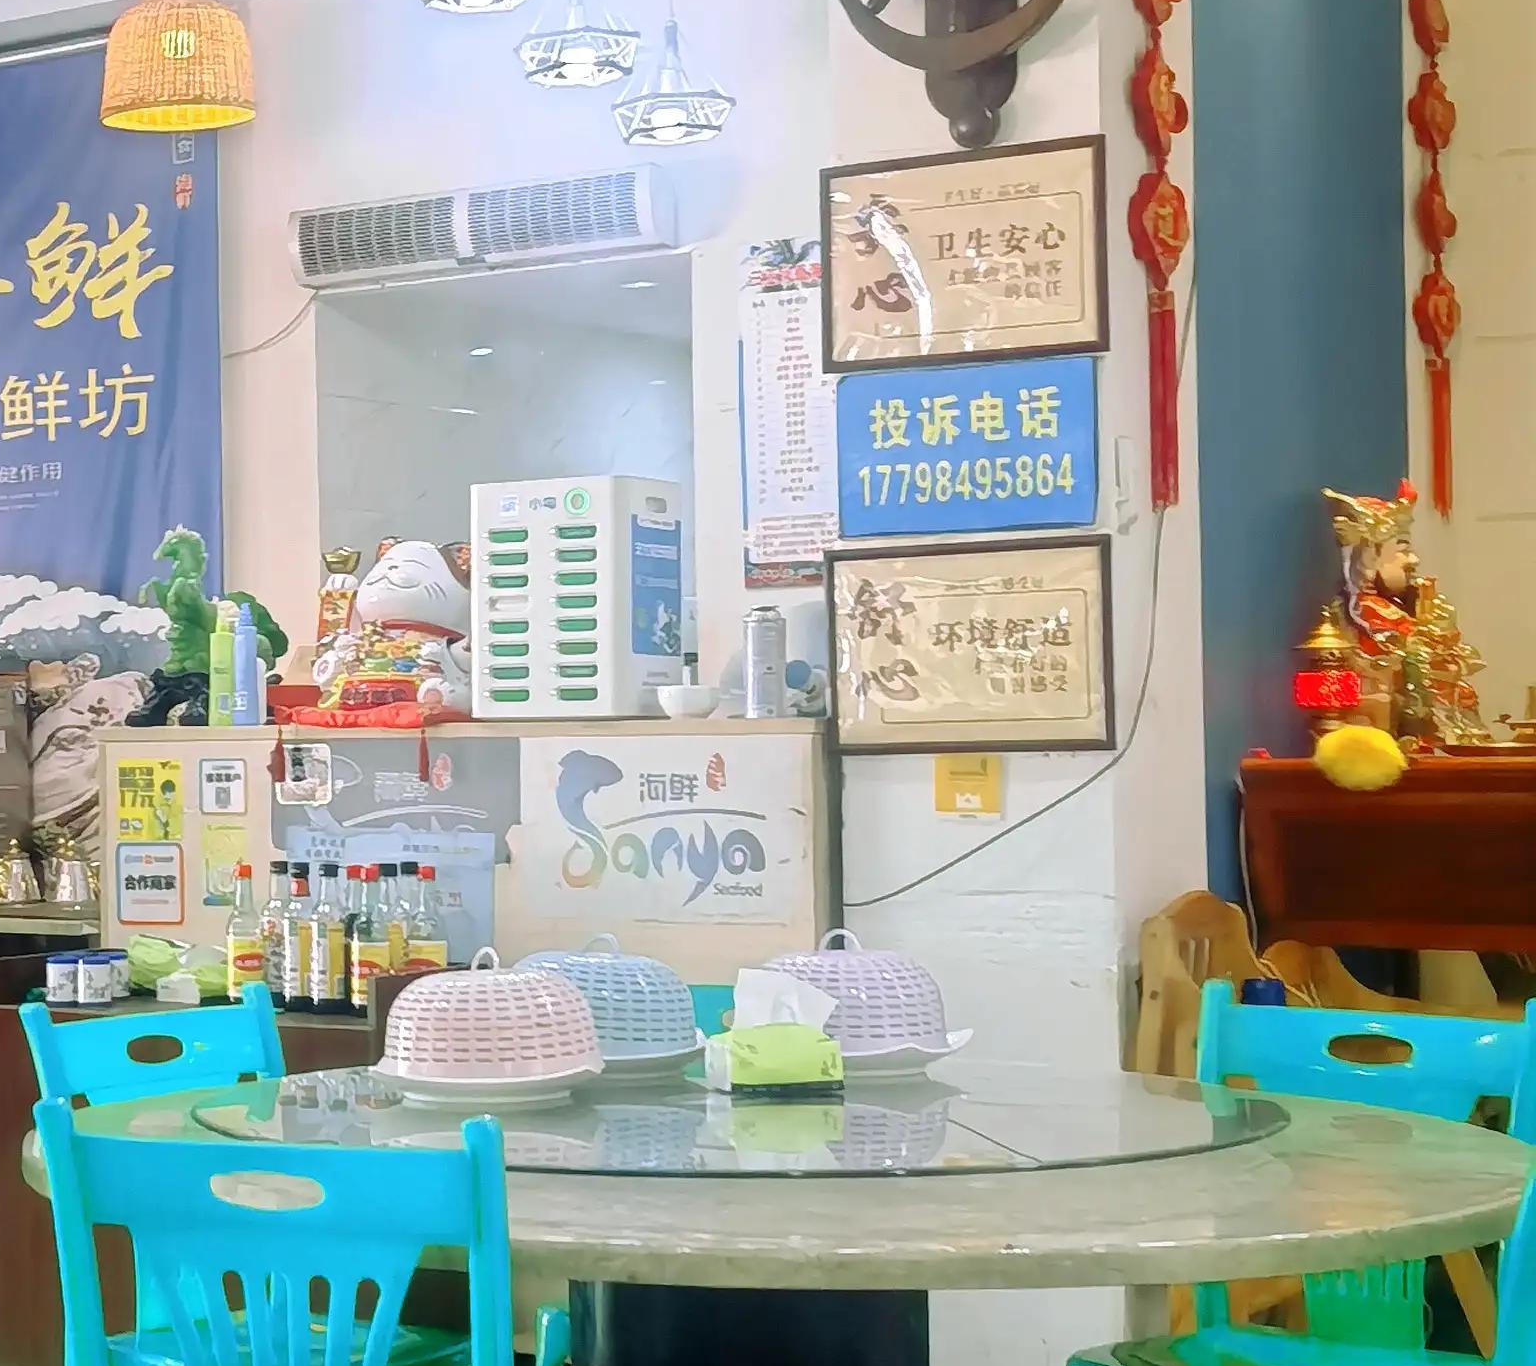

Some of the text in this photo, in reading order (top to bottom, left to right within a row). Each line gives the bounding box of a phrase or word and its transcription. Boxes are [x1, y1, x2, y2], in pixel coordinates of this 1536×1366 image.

[928, 221, 1065, 261] 卫生安心
[869, 386, 1061, 450] 投诉电话
[858, 453, 1076, 507] 17798495864
